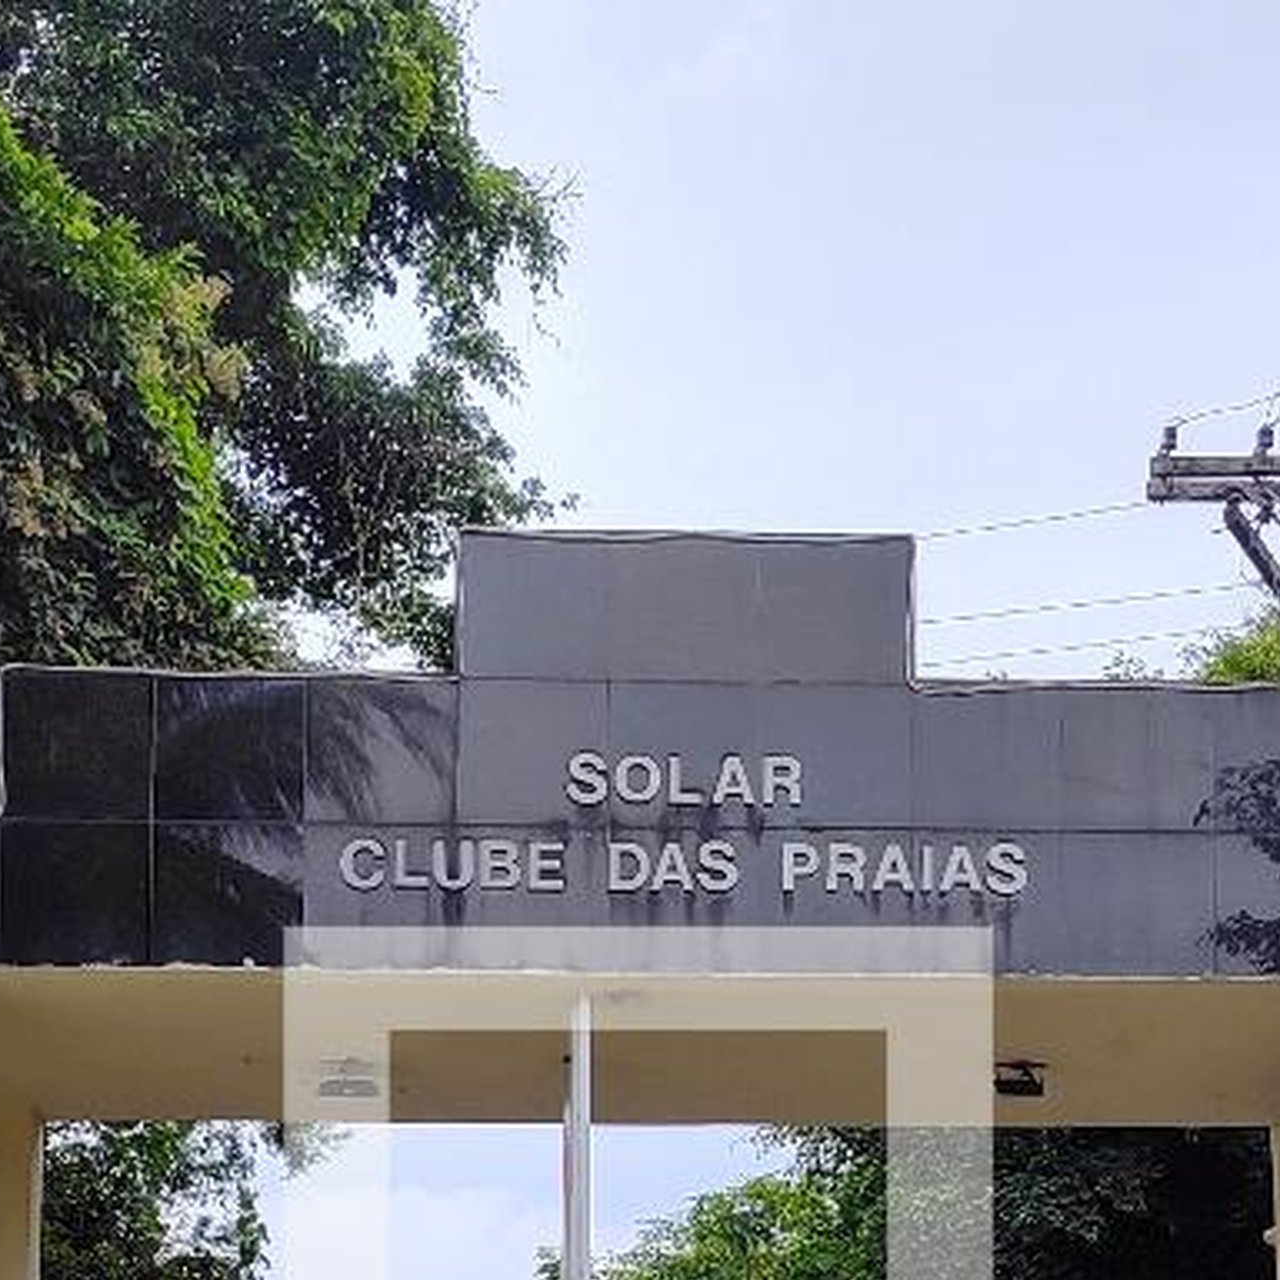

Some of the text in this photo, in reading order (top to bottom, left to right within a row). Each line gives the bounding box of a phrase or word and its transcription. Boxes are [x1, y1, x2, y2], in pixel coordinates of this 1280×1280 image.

[564, 751, 804, 806] SOLAR
[337, 839, 1030, 897] CLUBE DAS PRAIAS
